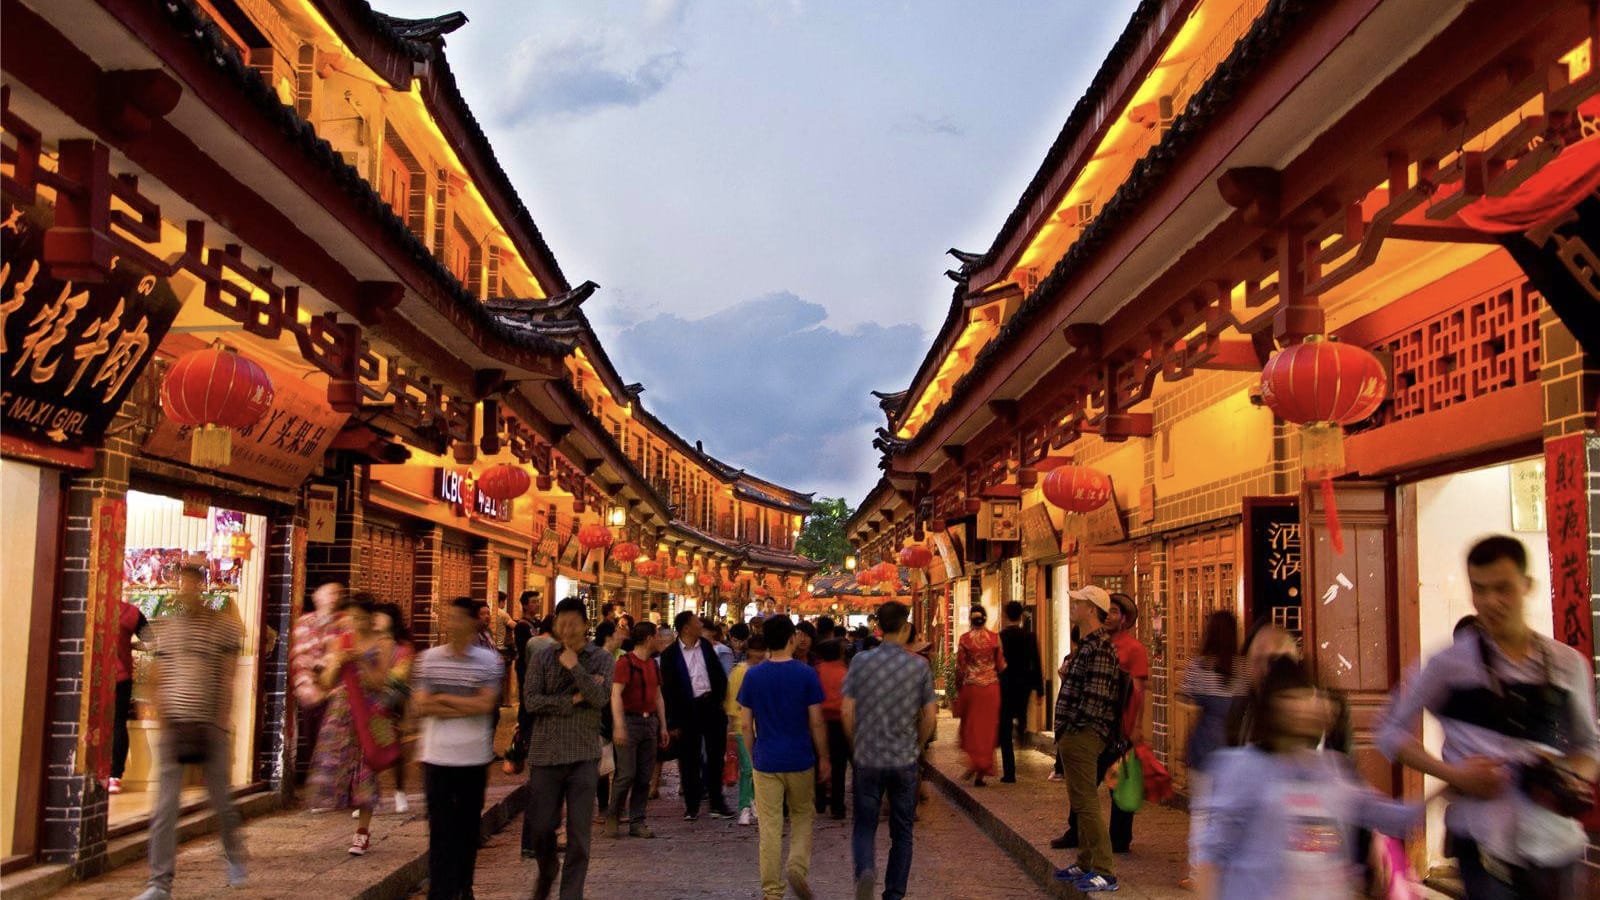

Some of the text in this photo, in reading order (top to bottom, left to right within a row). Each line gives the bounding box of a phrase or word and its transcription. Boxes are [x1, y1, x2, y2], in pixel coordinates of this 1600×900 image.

[7, 396, 55, 426] NAXI
[52, 408, 88, 435] GIRL
[441, 467, 464, 505] ICBC
